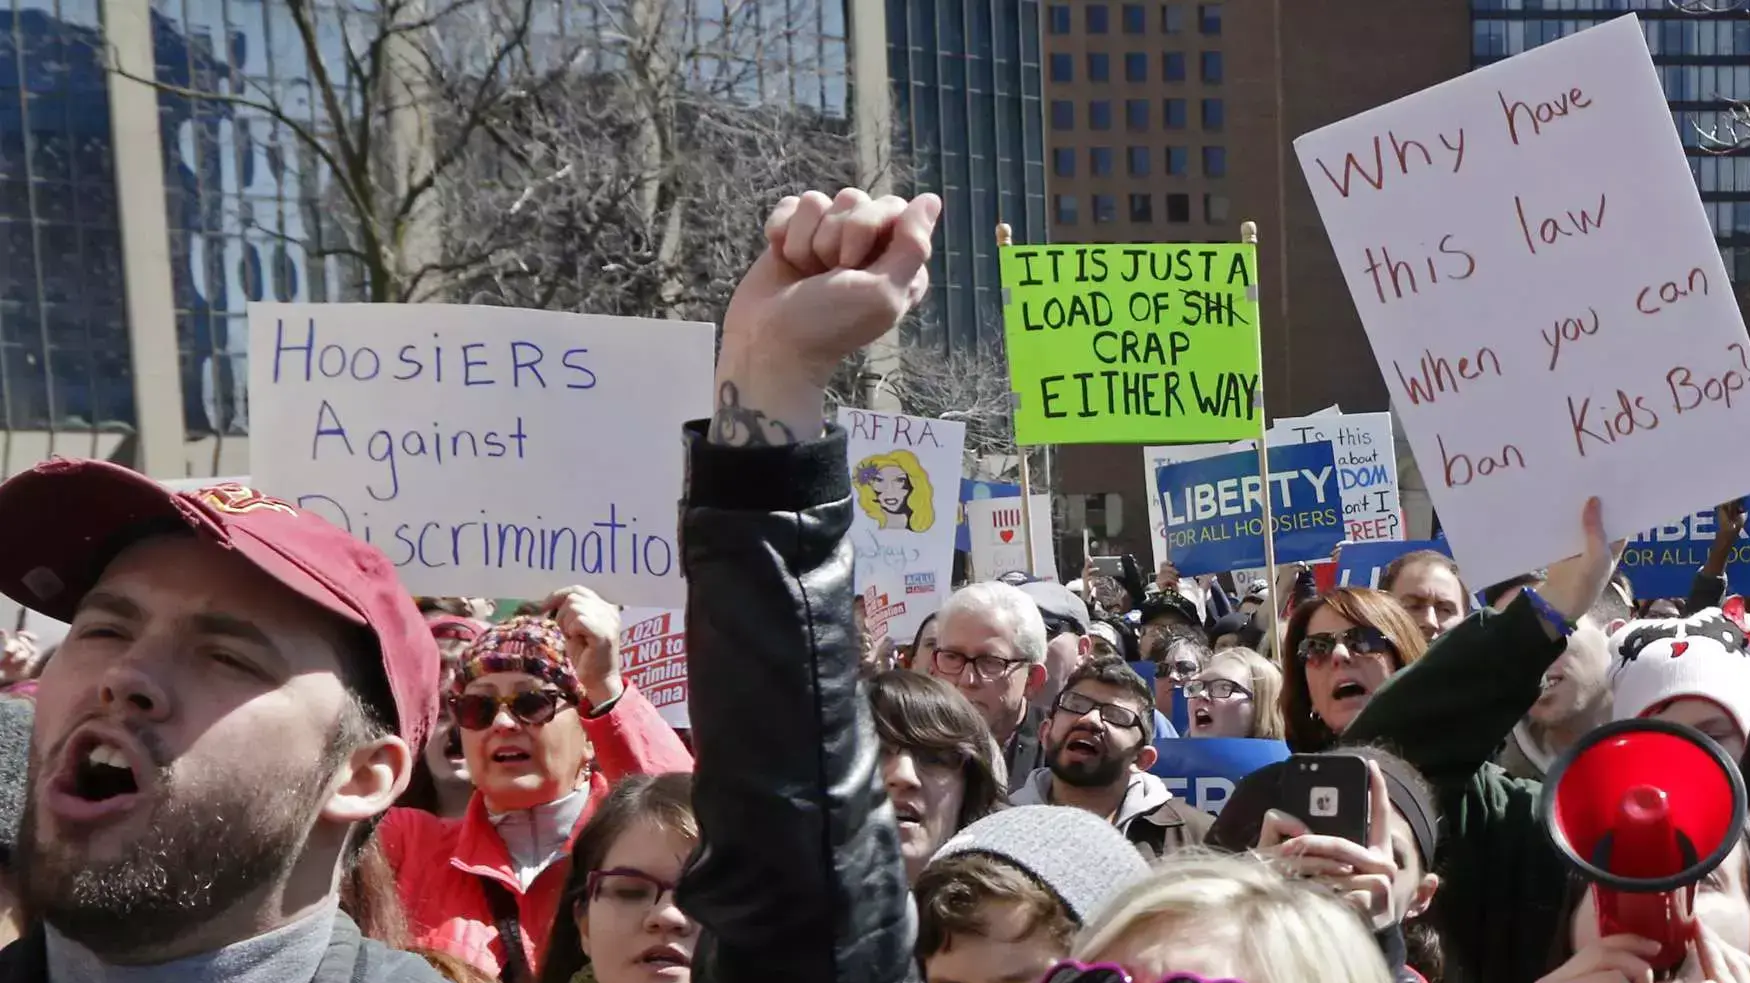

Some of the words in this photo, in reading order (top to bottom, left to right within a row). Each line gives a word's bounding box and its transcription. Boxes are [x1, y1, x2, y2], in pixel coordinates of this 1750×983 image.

[1316, 128, 1466, 199] Why
[1498, 86, 1594, 145] have
[1014, 250, 1065, 287] IT
[1075, 248, 1109, 283] IS
[1121, 248, 1218, 283] JUST
[1227, 252, 1250, 287] A
[1364, 234, 1476, 303] this
[1514, 193, 1606, 254] law
[1022, 291, 1114, 332] LOAD
[1129, 291, 1170, 325] OF
[1093, 330, 1191, 366] CRAP
[1394, 346, 1502, 406] When
[1541, 308, 1600, 371] you
[1635, 266, 1710, 314] can
[1040, 370, 1186, 419] EITHER
[1189, 370, 1259, 421] WAY
[311, 400, 529, 501] Against
[1337, 427, 1373, 446] this
[1337, 448, 1379, 465] about
[1437, 434, 1526, 489] ban
[1568, 388, 1660, 456] Kids
[1162, 465, 1334, 527] LIBERTY
[1340, 464, 1393, 490] DOM.
[1342, 494, 1370, 514] on't
[1372, 490, 1390, 513] I
[297, 494, 685, 577] Discriminatio
[1168, 527, 1197, 549] FOR
[1199, 525, 1231, 544] ALL
[1235, 508, 1337, 537] HOOSIERS
[1621, 549, 1654, 566] OR
[1660, 549, 1701, 565] ALL
[638, 638, 662, 664] NO
[666, 637, 684, 655] to
